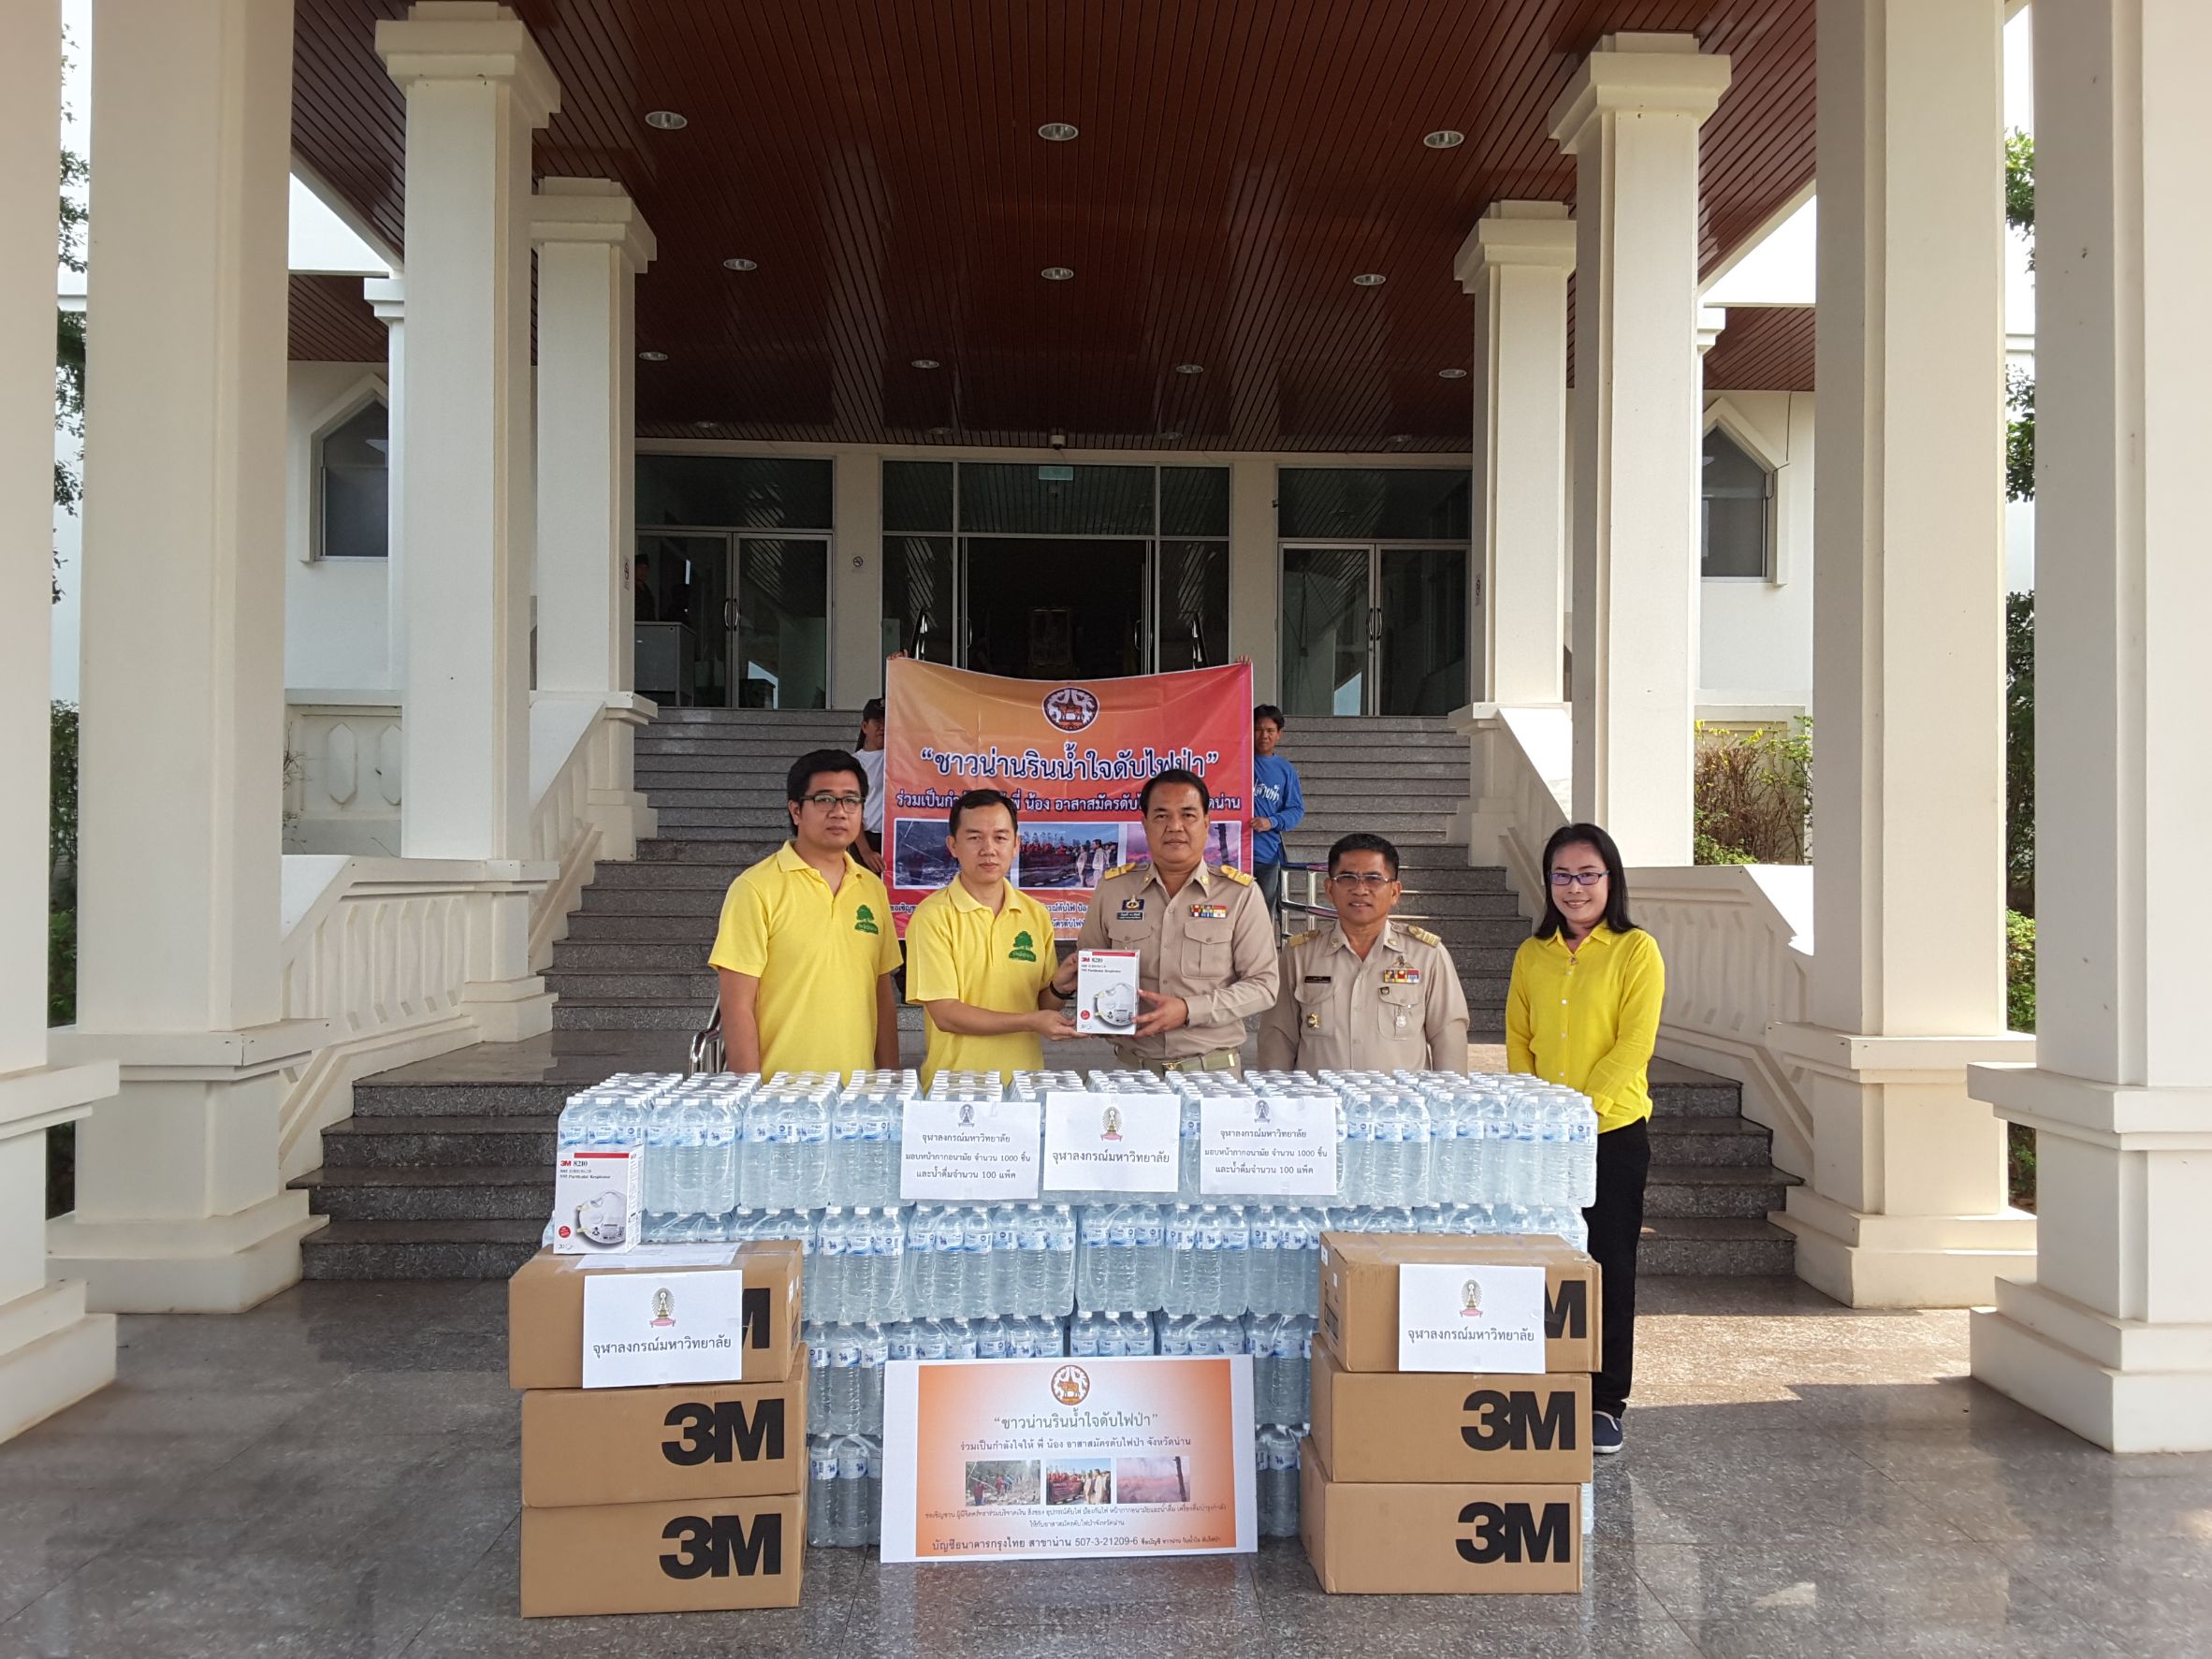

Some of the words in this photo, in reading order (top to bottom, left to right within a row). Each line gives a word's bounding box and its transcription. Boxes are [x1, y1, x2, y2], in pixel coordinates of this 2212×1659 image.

[1026, 793, 1050, 810] น้อง
[922, 1132, 1011, 1144] จุฬาลงกรณ์มหาวิทยาลัย
[1220, 1128, 1306, 1140] จุฬาลงกรณ์มหาวิทยาลัย
[1052, 1148, 1170, 1164] จุฬาลงกรณ์มหาวิทยาลัย
[982, 1171, 997, 1180] 100
[1280, 1166, 1293, 1174] 100
[1407, 1327, 1535, 1343] จุฬาลงกรณ์มหาวิทยาลัย
[592, 1336, 732, 1360] จุฬาลงกรณ์มหาวิทยาลัย
[1461, 1390, 1576, 1451] 3M
[662, 1398, 785, 1466] 3M
[960, 1439, 1034, 1450] ร่วมเป็นกำลังใจให้
[1047, 1438, 1064, 1448] น้อง
[1067, 1436, 1144, 1448] อาสาสมัครดับไฟป่า
[1147, 1435, 1191, 1447] จังหวัดน่าน
[1456, 1502, 1570, 1564] 3M
[659, 1513, 781, 1579] 3M
[932, 1536, 1025, 1552] บัญชีธนาคารกรุงไทย
[1029, 1536, 1071, 1547] สาขาน่าน
[1075, 1537, 1138, 1547] 507-3-21209-6
